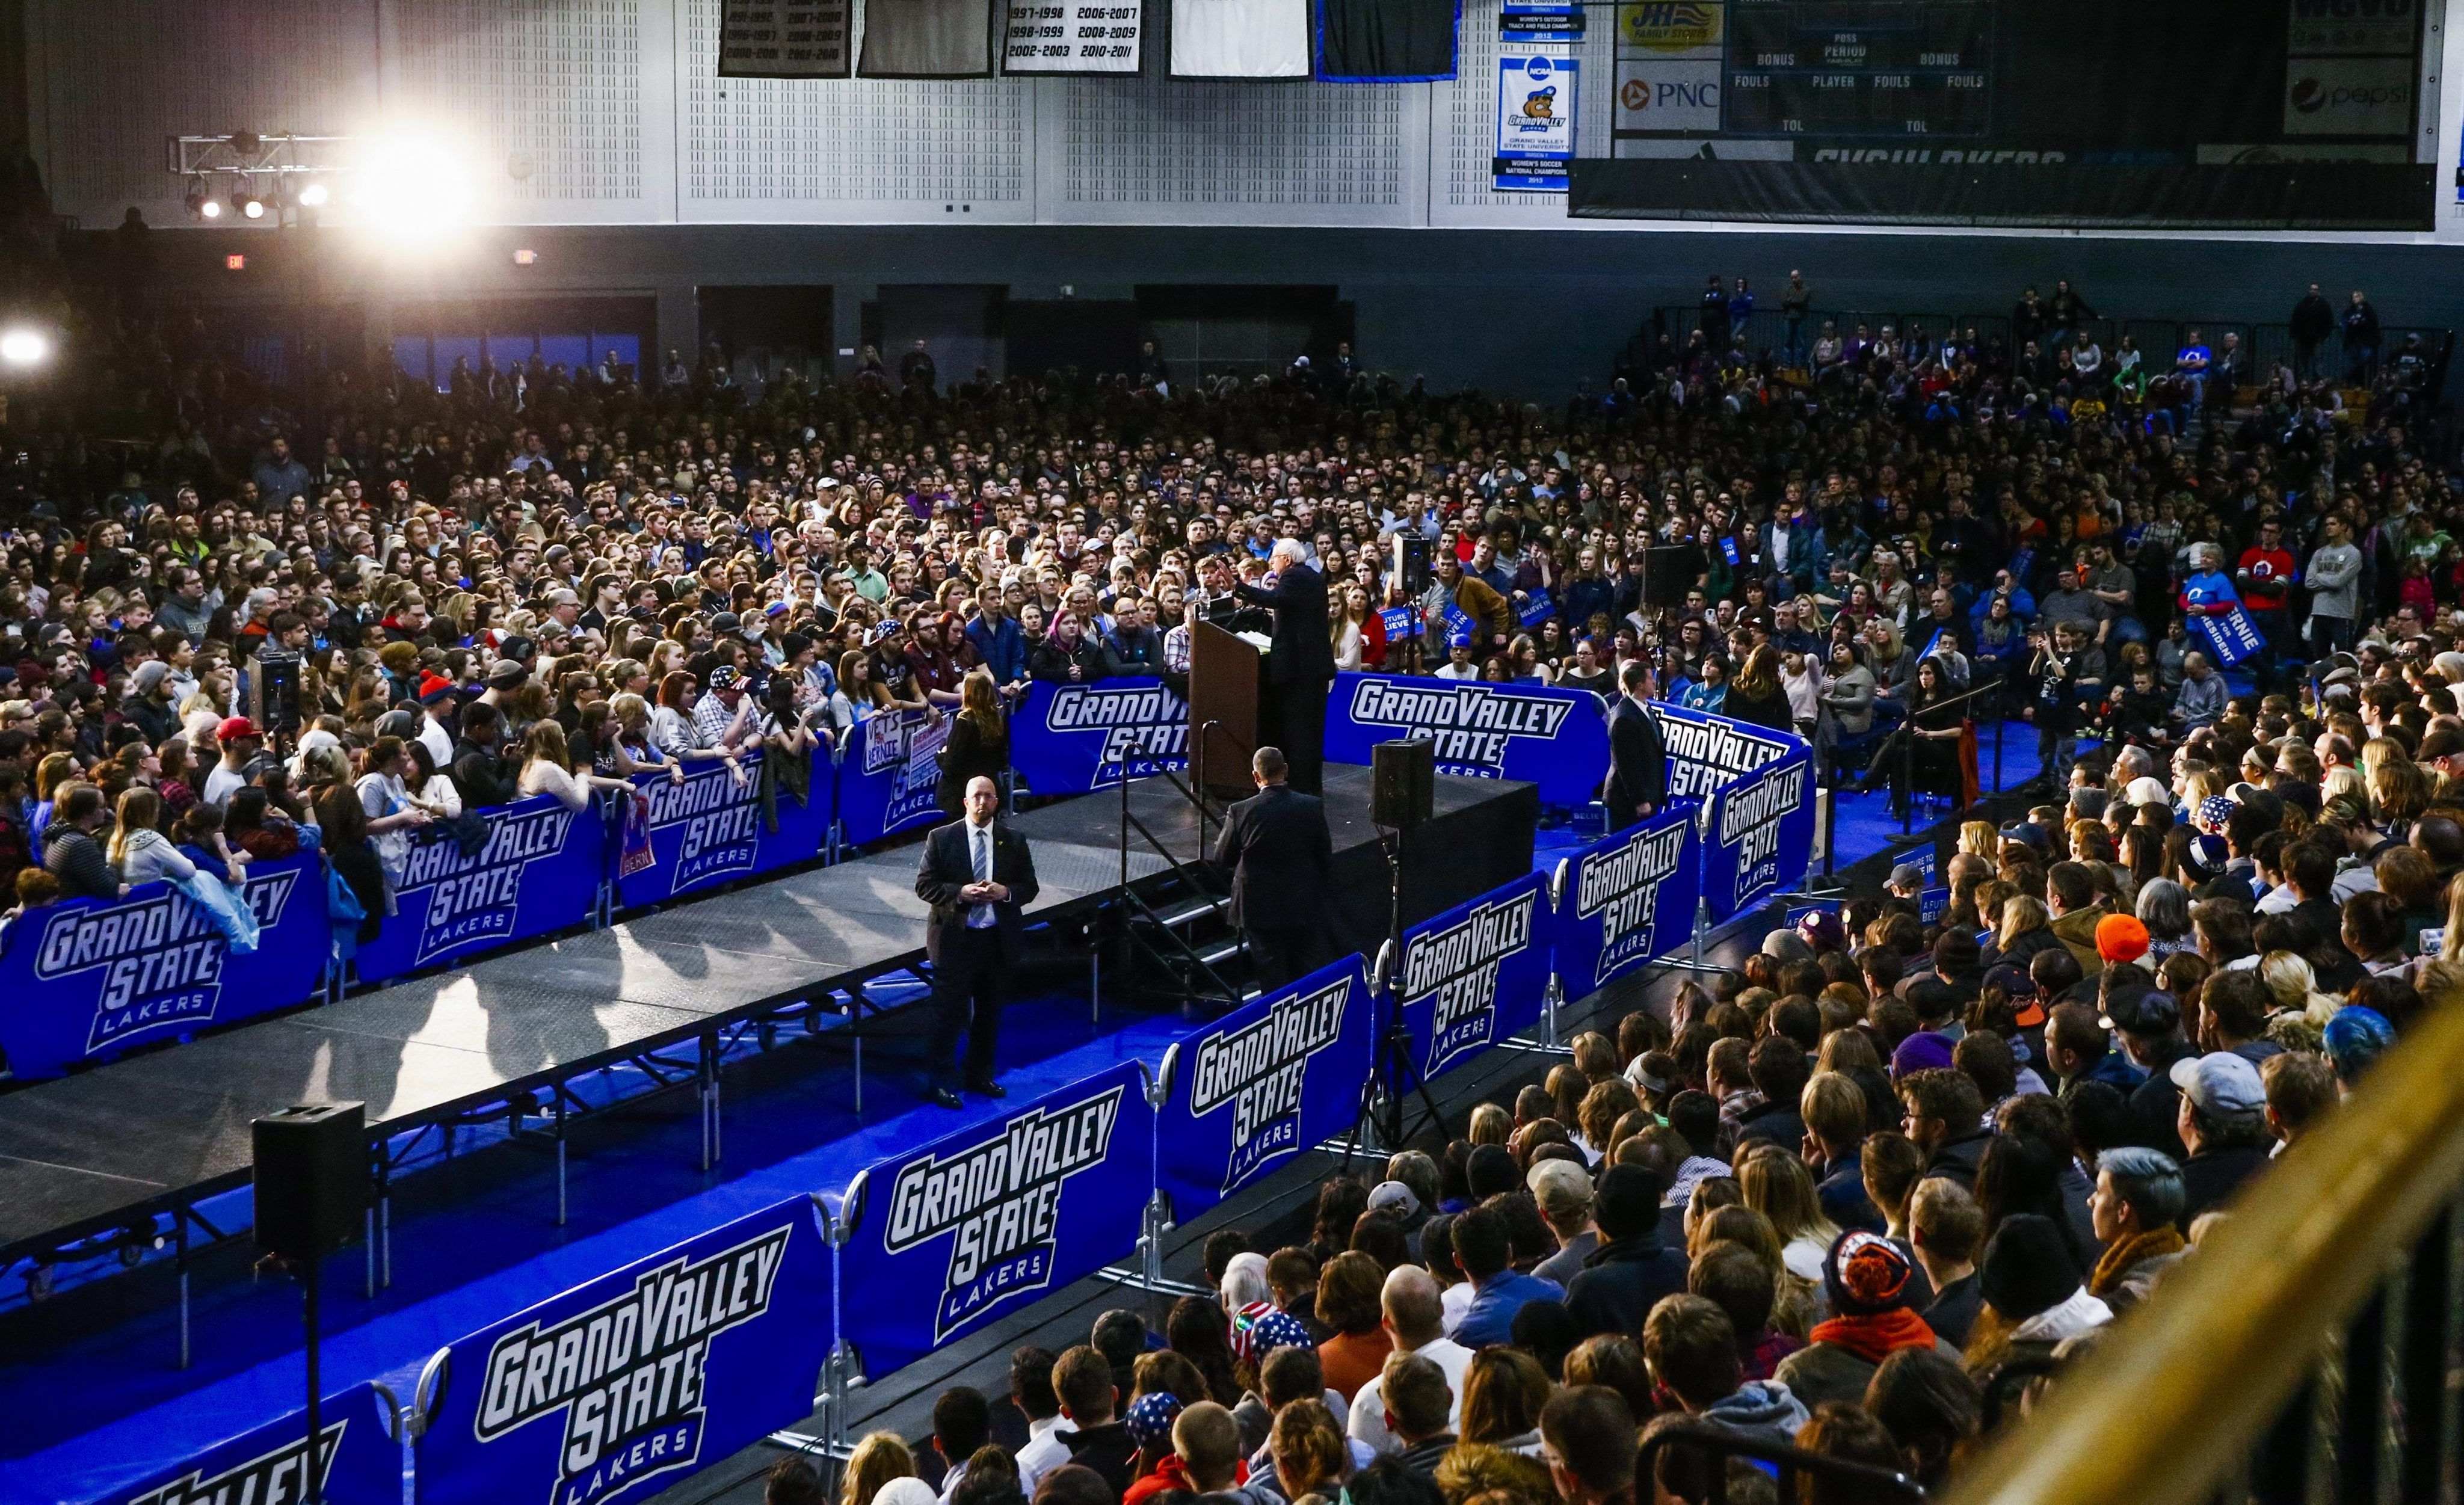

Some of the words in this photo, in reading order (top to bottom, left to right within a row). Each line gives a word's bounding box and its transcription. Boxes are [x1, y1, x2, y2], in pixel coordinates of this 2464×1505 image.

[1011, 7, 1064, 19] 1997-1998
[1077, 7, 1137, 19] 2006-2007
[1011, 26, 1064, 38] 1998-1999
[1078, 26, 1136, 38] 2008-2009
[1834, 33, 1857, 43] POSS
[1008, 45, 1071, 57] 2002-2003
[1080, 45, 1132, 57] 2010-2011
[1757, 54, 1794, 66] BONUS
[1825, 46, 1866, 57] PERIOD
[1920, 52, 1959, 66] BONUS
[1734, 76, 1770, 87] FOULS
[1813, 75, 1855, 87] PLAYER
[1874, 76, 1911, 87] FOULS
[1948, 76, 1983, 87] FOULS
[1656, 82, 1718, 108] PNC
[2332, 84, 2407, 108] pepsi
[1782, 120, 1804, 132] TOL
[1906, 120, 1927, 132] TOL
[1726, 549, 1735, 557] IN
[1384, 613, 1407, 623] UTURE
[1385, 620, 1409, 630] LIEVE
[1452, 610, 1462, 620] TO
[1458, 614, 1468, 625] IN
[2201, 615, 2235, 661] RESIDENT
[2220, 621, 2231, 637] FOR
[868, 712, 901, 740] VETS
[868, 739, 899, 767] BERNIE
[1106, 724, 1189, 762] STAT
[1672, 760, 1744, 796] STAT
[892, 794, 934, 819] LAKER
[685, 804, 759, 859] STATE
[624, 851, 649, 873] BERN
[683, 849, 748, 878] LAKERS
[1926, 854, 1934, 863] TO
[430, 864, 522, 926] STATE
[1605, 882, 1656, 948] STATE
[428, 913, 506, 949] LAKERS
[1603, 934, 1646, 969] LAKERS
[104, 938, 223, 1011] STATE
[1435, 960, 1496, 1035] STATE
[102, 994, 205, 1035] LAKERS
[1435, 1017, 1485, 1059] LAKERS
[1236, 1057, 1304, 1146] STATE
[1235, 1122, 1292, 1175] LAKERS
[953, 1180, 1056, 1286] STATE
[949, 1255, 1040, 1317] LAKERS
[568, 1340, 704, 1473] STATE
[566, 1428, 687, 1505] LAKERS
